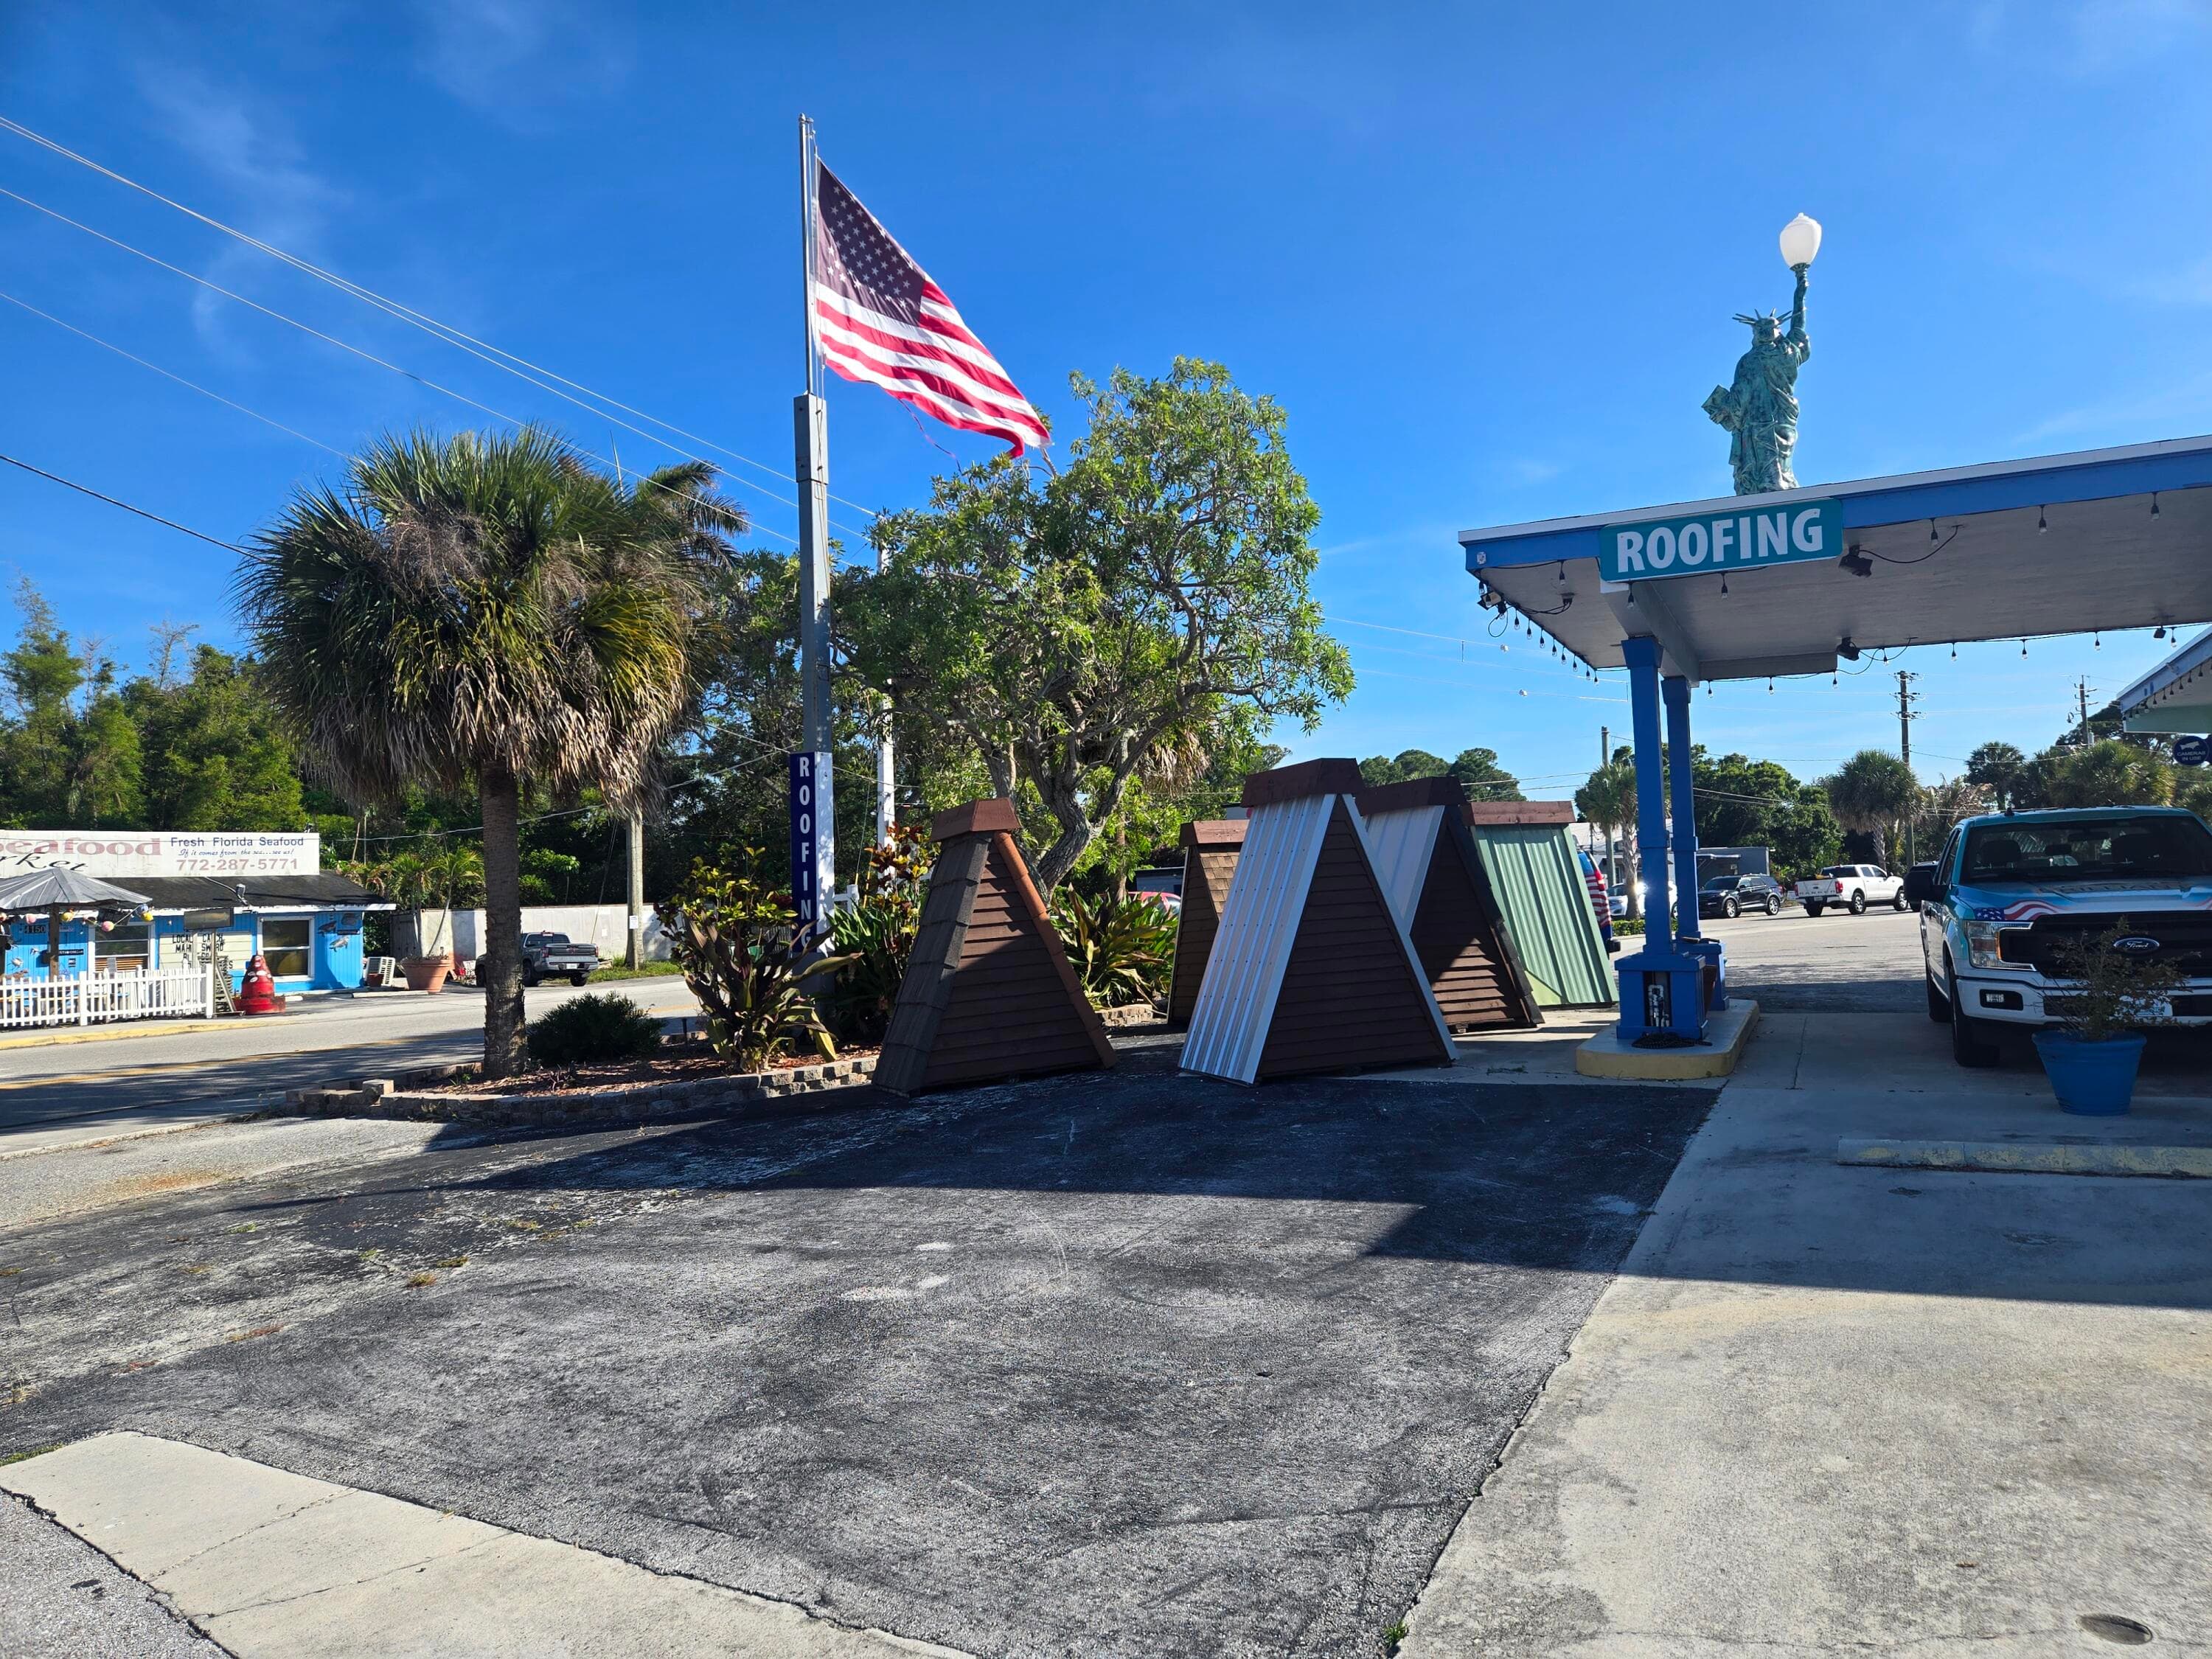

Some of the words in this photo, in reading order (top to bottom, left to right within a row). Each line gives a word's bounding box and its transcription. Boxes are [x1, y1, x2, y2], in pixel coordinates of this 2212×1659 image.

[1616, 508, 1823, 574] ROOFING
[171, 837, 204, 846] Fresh
[213, 837, 253, 846] Florida
[259, 837, 304, 846] Seafood
[0, 838, 162, 855] eafood
[178, 849, 189, 858] If
[220, 849, 237, 858] from
[799, 757, 811, 947] ROOFING
[176, 858, 297, 871] 772-287-5771
[172, 934, 193, 943] LOCAL
[201, 944, 223, 952] SWRD
[2126, 940, 2149, 949] Ford
